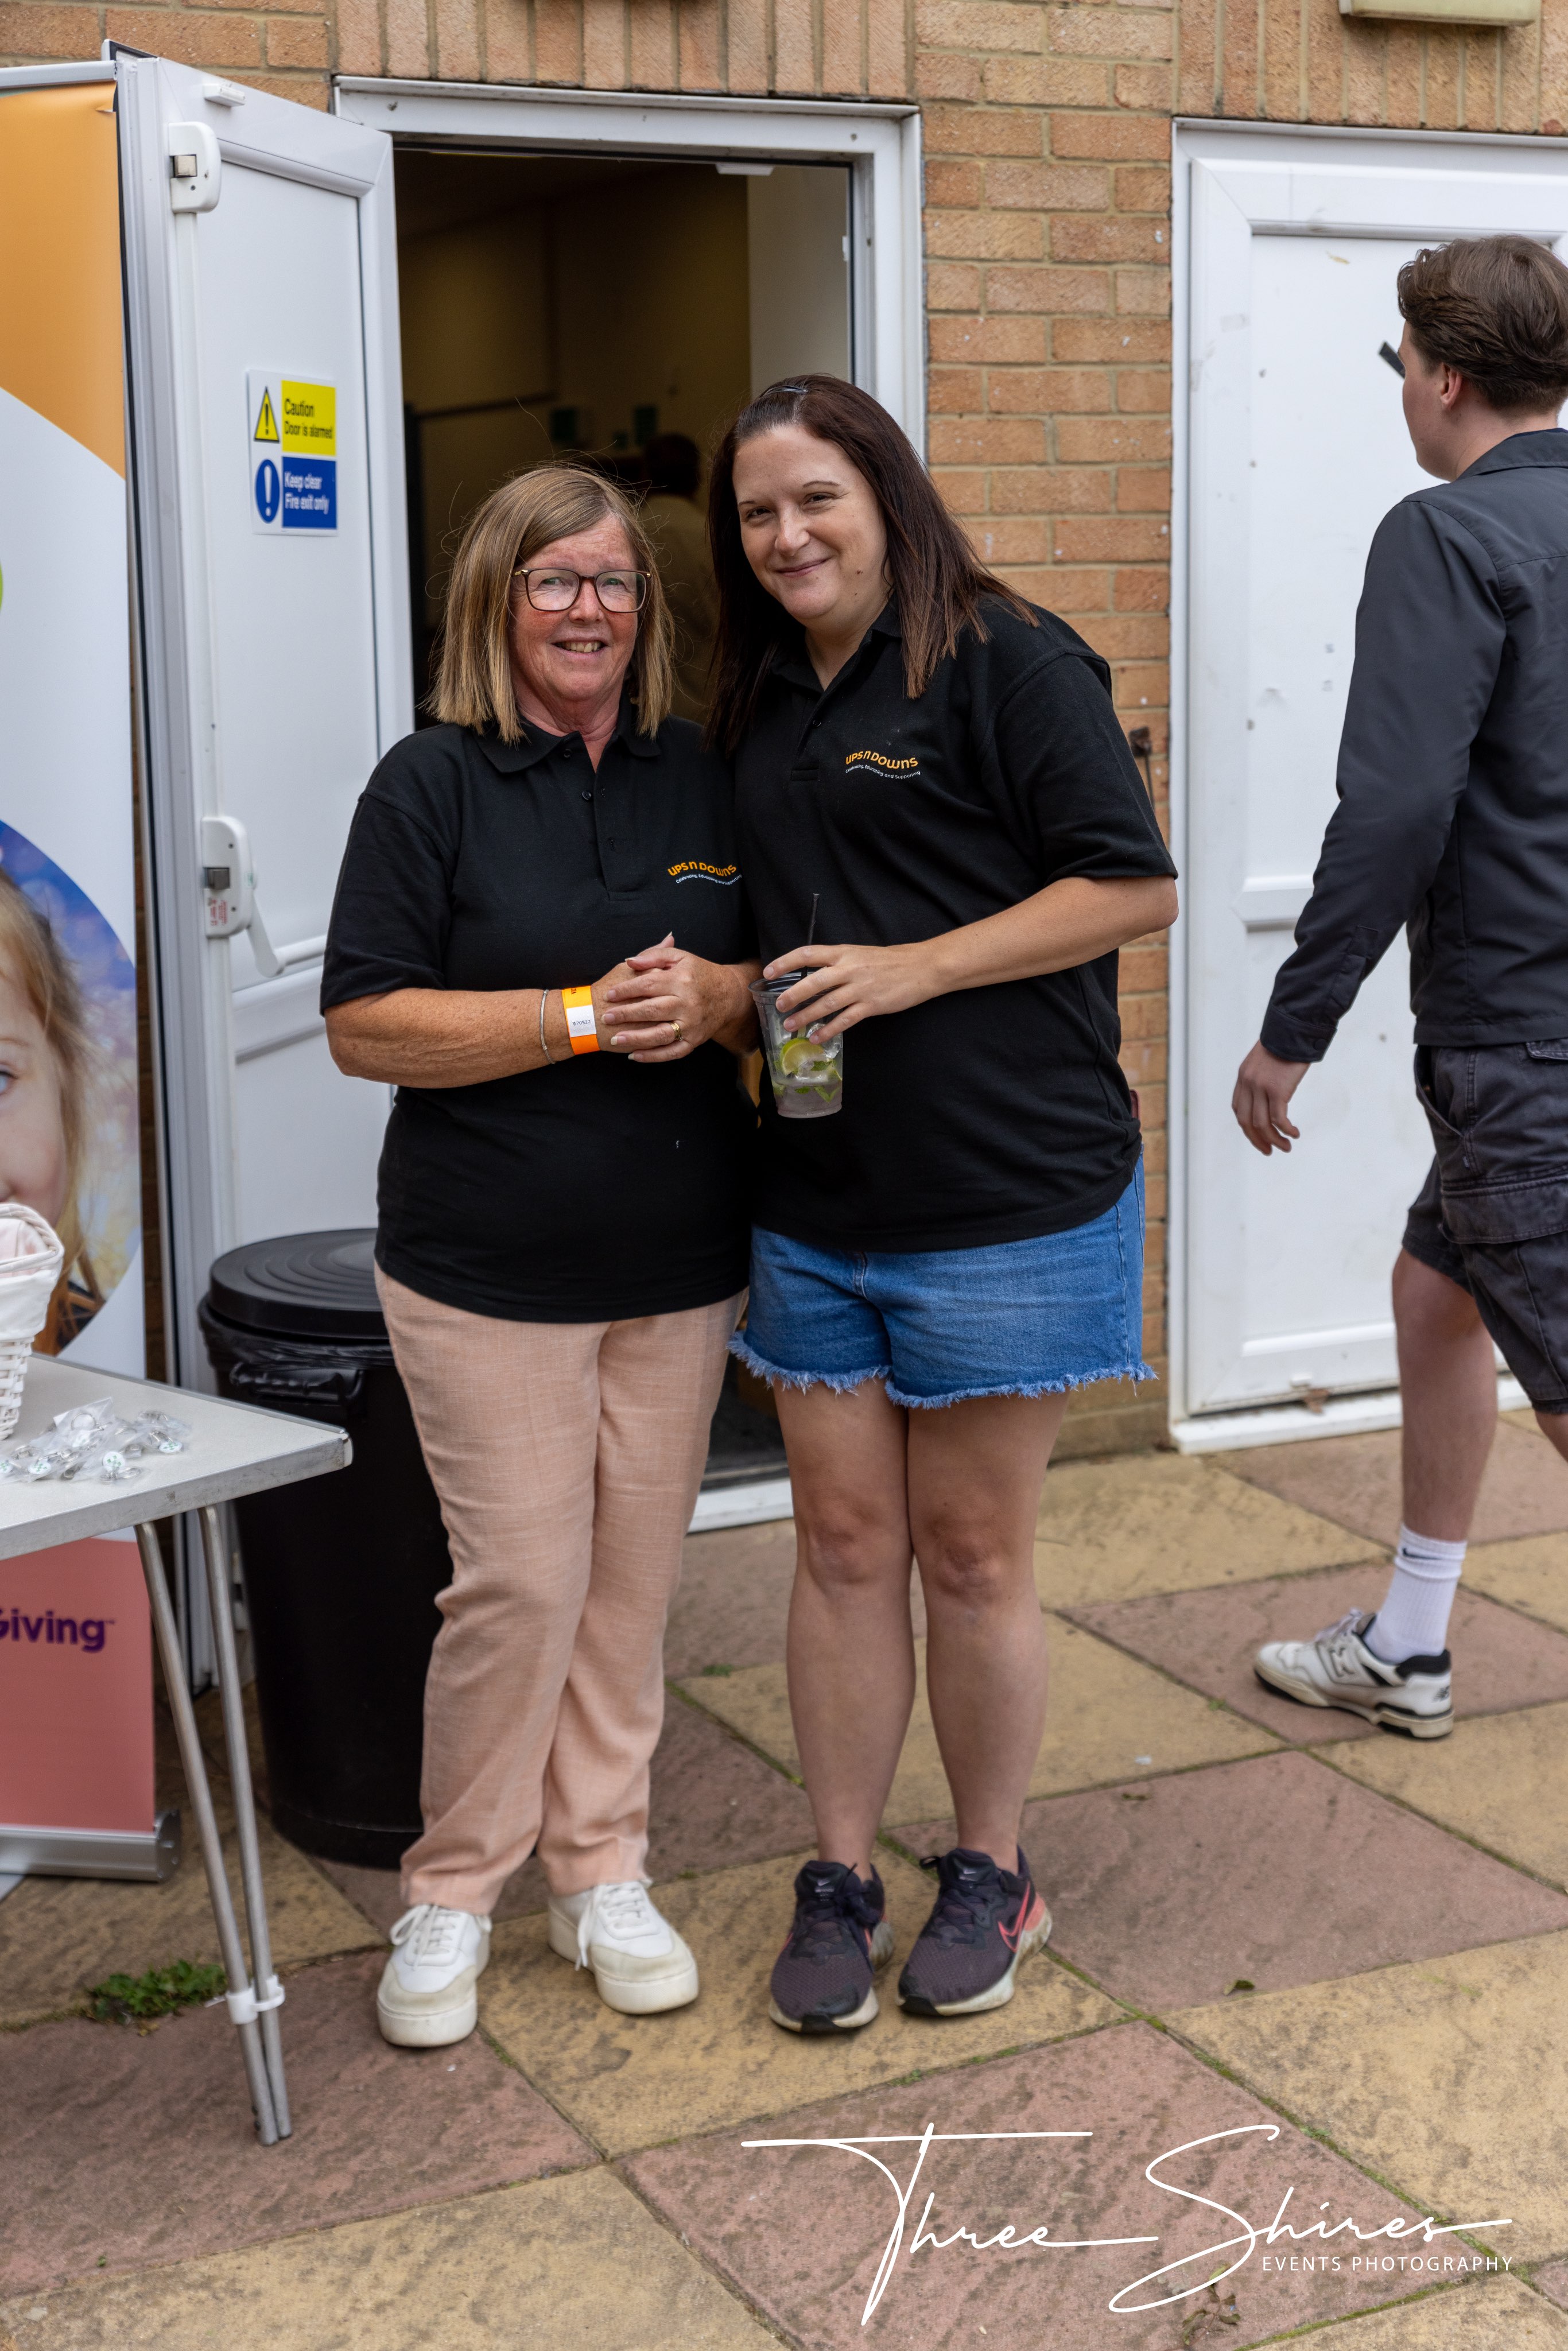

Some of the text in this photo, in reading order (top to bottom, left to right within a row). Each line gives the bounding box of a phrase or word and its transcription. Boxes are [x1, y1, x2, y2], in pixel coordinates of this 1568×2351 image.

[284, 397, 314, 417] Caution
[284, 421, 333, 440] Door is alarmed
[284, 471, 323, 492] Keep clear
[285, 492, 330, 515] Fire exit only
[864, 765, 884, 777] Educating
[895, 771, 921, 779] Supporting
[698, 874, 718, 883] Educating
